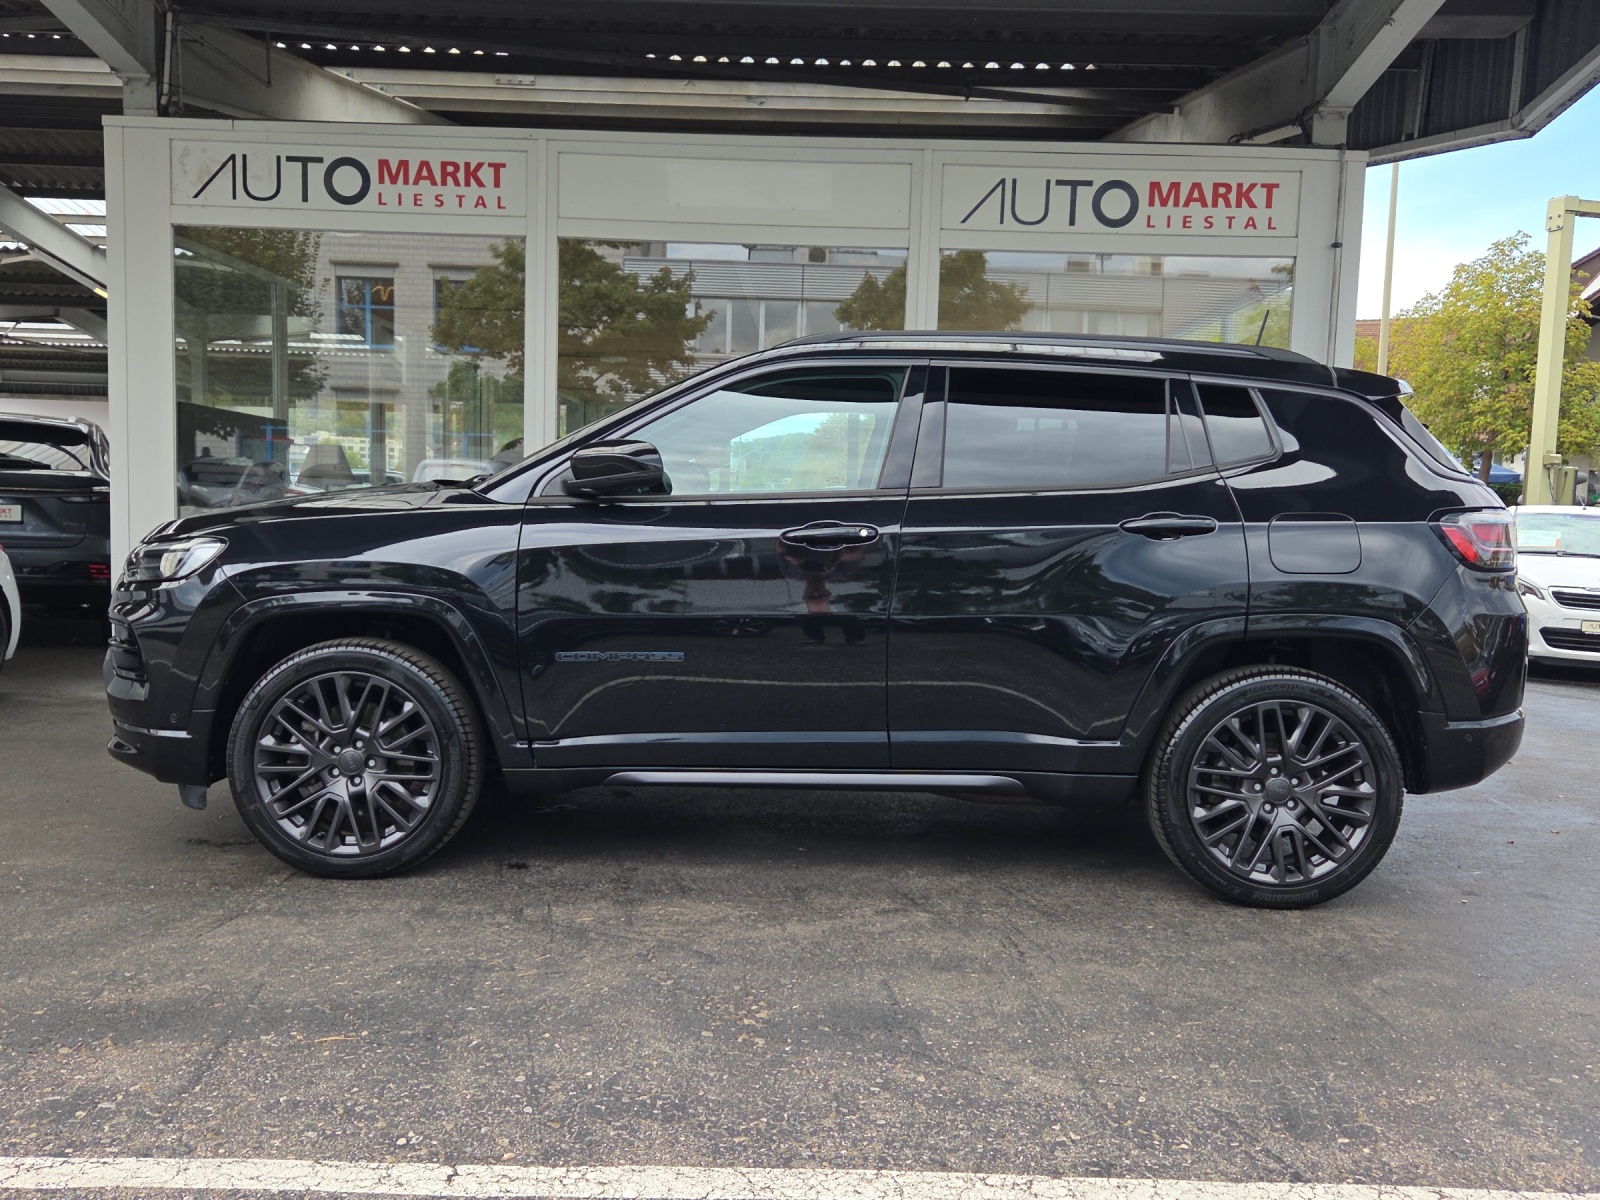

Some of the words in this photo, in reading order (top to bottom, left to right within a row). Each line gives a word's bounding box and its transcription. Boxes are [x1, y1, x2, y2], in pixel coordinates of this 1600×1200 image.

[192, 153, 371, 206] AUTO
[377, 158, 507, 189] MARKT
[377, 191, 507, 210] LIESTAL
[960, 177, 1140, 229] AUTO
[1147, 180, 1280, 209] MARKT
[1146, 213, 1277, 231] LIESTAL
[555, 651, 685, 662] COMPASS
